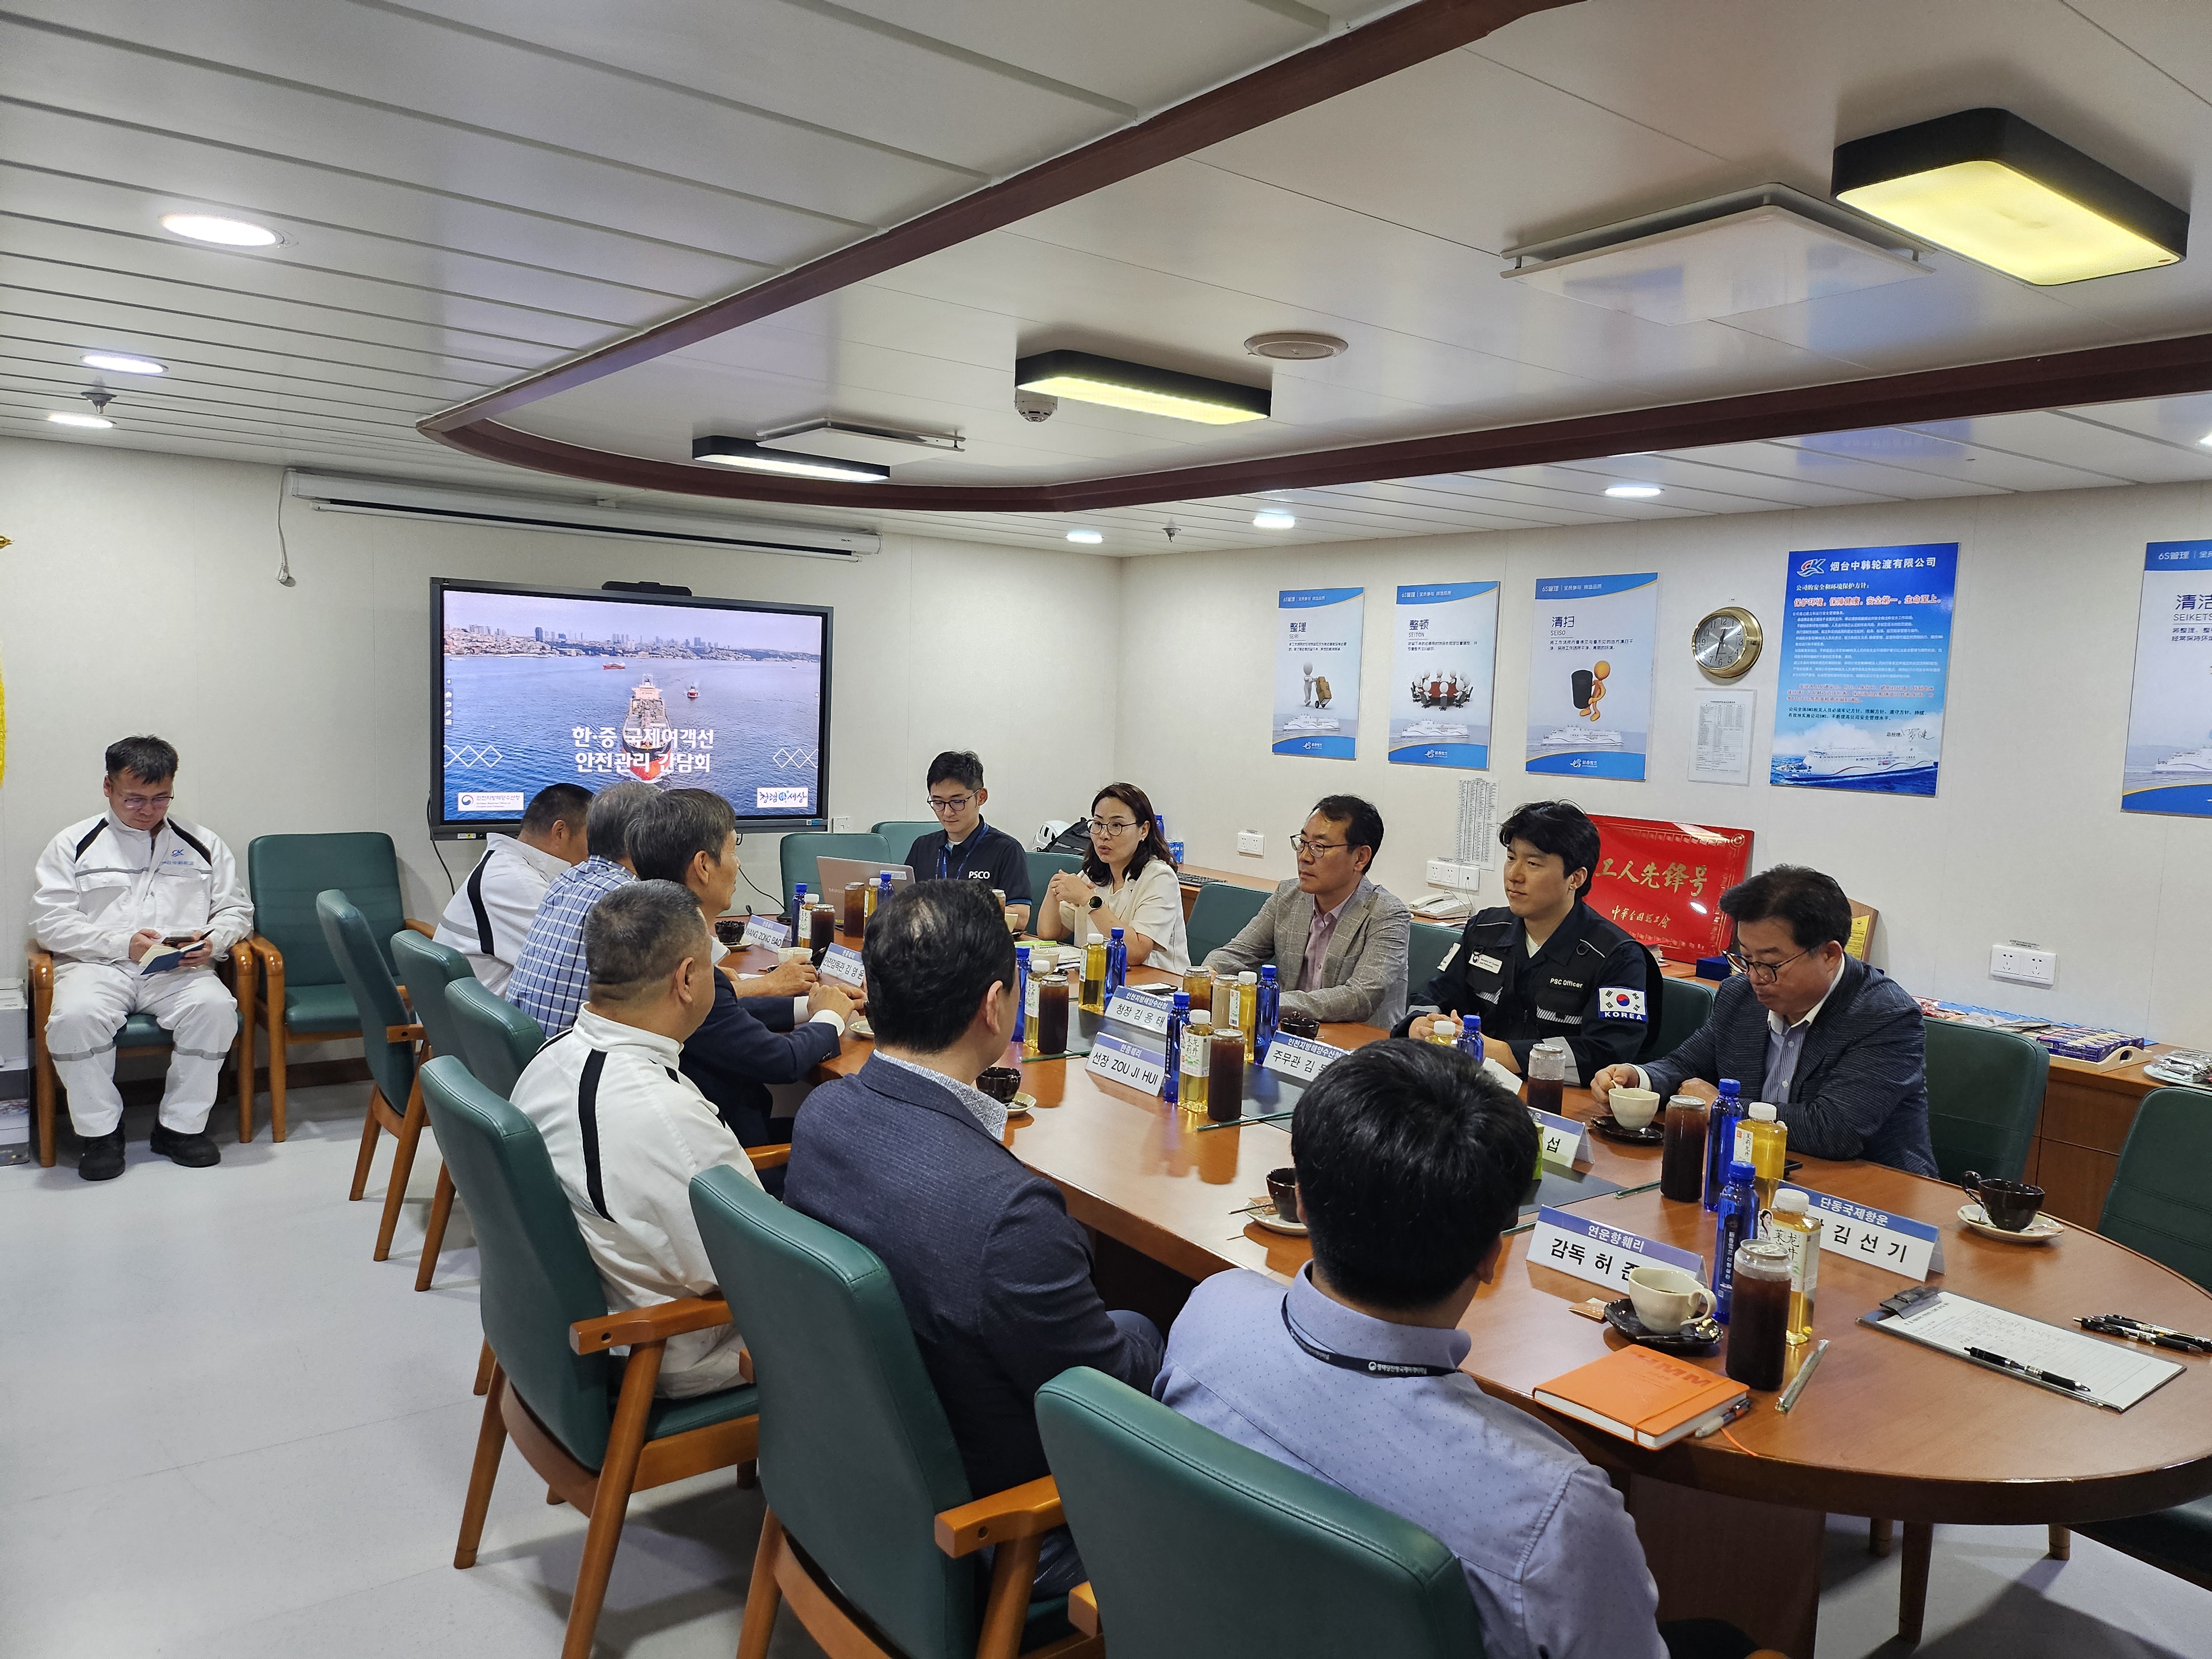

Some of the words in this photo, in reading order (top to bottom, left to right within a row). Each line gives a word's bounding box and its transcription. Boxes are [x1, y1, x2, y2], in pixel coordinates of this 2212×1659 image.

[2158, 550, 2190, 560] 6S管理
[1829, 556, 1937, 572] 烟台中韩轮渡有限公司
[1290, 622, 1307, 632] 整理
[1409, 619, 1429, 630] 整顿
[1551, 615, 1575, 628] 清扫
[1720, 617, 1727, 625] 12
[1738, 638, 1744, 646] 3
[1718, 658, 1723, 666] 6
[572, 726, 618, 749] 한·중
[624, 727, 714, 749] 국제여객선
[575, 752, 650, 774] 안전관리
[657, 753, 711, 774] 간담회
[968, 870, 990, 879] PSCO
[1595, 858, 1708, 897] 工人先锋号
[746, 927, 759, 939] WANG
[758, 932, 772, 943] ZONG
[771, 936, 782, 947] BAO
[844, 964, 852, 975] 김
[851, 966, 858, 977] 영
[1563, 979, 1583, 988] Officer
[1126, 992, 1168, 1010] 인천지방해양수산청
[1116, 1003, 1133, 1017] 청장
[1134, 1009, 1144, 1020] 김
[1144, 1013, 1154, 1024] 용
[1156, 1016, 1166, 1027] 태
[1604, 1011, 1643, 1020] KOREA
[1120, 1044, 1142, 1058] 한중훼리
[1288, 1038, 1342, 1060] 인천지방해양수산청
[1092, 1052, 1109, 1067] 선장
[1110, 1059, 1130, 1074] ZOU
[1131, 1067, 1140, 1079] JI
[1141, 1070, 1159, 1086] HUI
[1272, 1050, 1301, 1069] 주무관
[1304, 1060, 1316, 1073] 김
[1546, 1137, 1561, 1154] 섭
[1820, 1196, 1888, 1227] 단동국제항운
[1588, 1224, 1645, 1253] 연운항훼리
[1834, 1224, 1851, 1245] 김
[1860, 1233, 1879, 1254] 선
[1887, 1242, 1907, 1263] 기
[1551, 1238, 1586, 1265] 감독
[1594, 1253, 1614, 1275] 허
